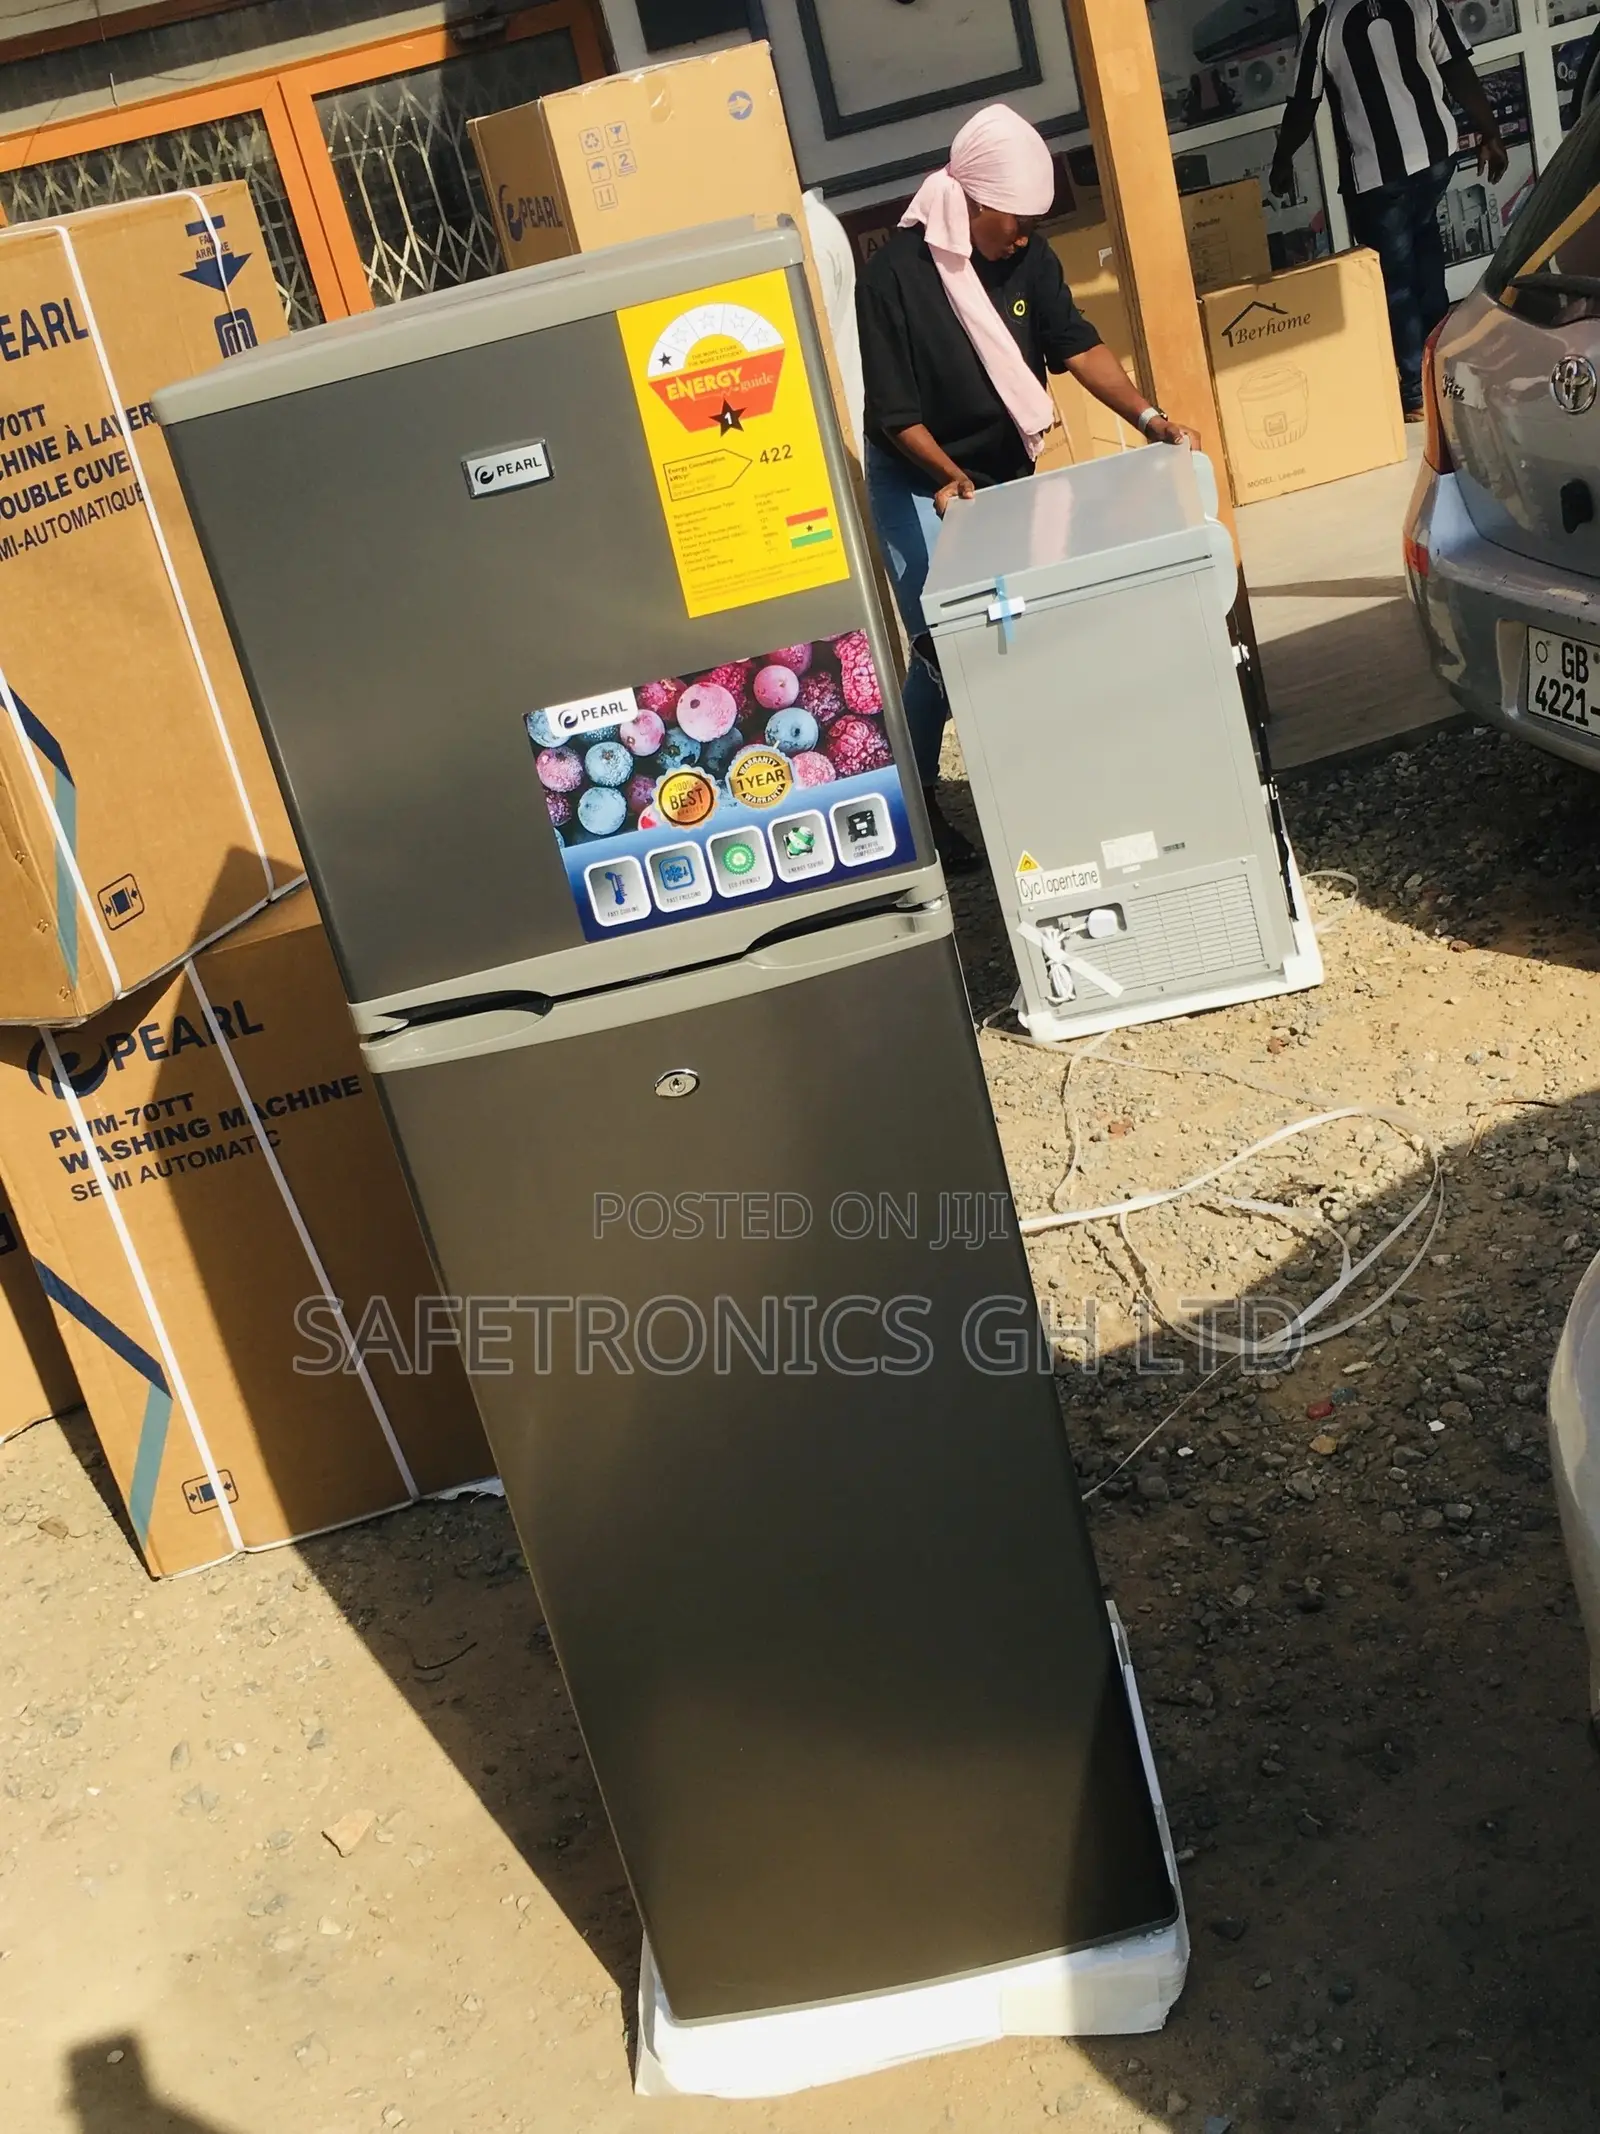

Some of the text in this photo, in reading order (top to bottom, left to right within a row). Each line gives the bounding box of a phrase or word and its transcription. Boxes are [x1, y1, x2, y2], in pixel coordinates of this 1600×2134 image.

[519, 196, 563, 228] PEARL
[1236, 313, 1311, 344] Berhome
[665, 367, 774, 402] ENERGY guide
[724, 411, 733, 425] 1
[0, 436, 61, 481] HINE
[64, 424, 83, 455] À
[496, 457, 542, 477] PEARL
[760, 444, 792, 464] 422
[0, 450, 130, 520] OUBLE CUVE
[1562, 641, 1589, 684] GB
[581, 701, 628, 721] PEARL
[740, 756, 777, 775] WARRANTY
[745, 769, 786, 789] YEAR
[669, 787, 704, 810] BEST
[745, 784, 783, 804] WARRANTY
[1020, 870, 1098, 900] Cyclopentane
[105, 1000, 264, 1071] PEARL
[59, 1074, 362, 1174] WASHING MACHINE
[140, 1129, 282, 1184] AUTOMATC
